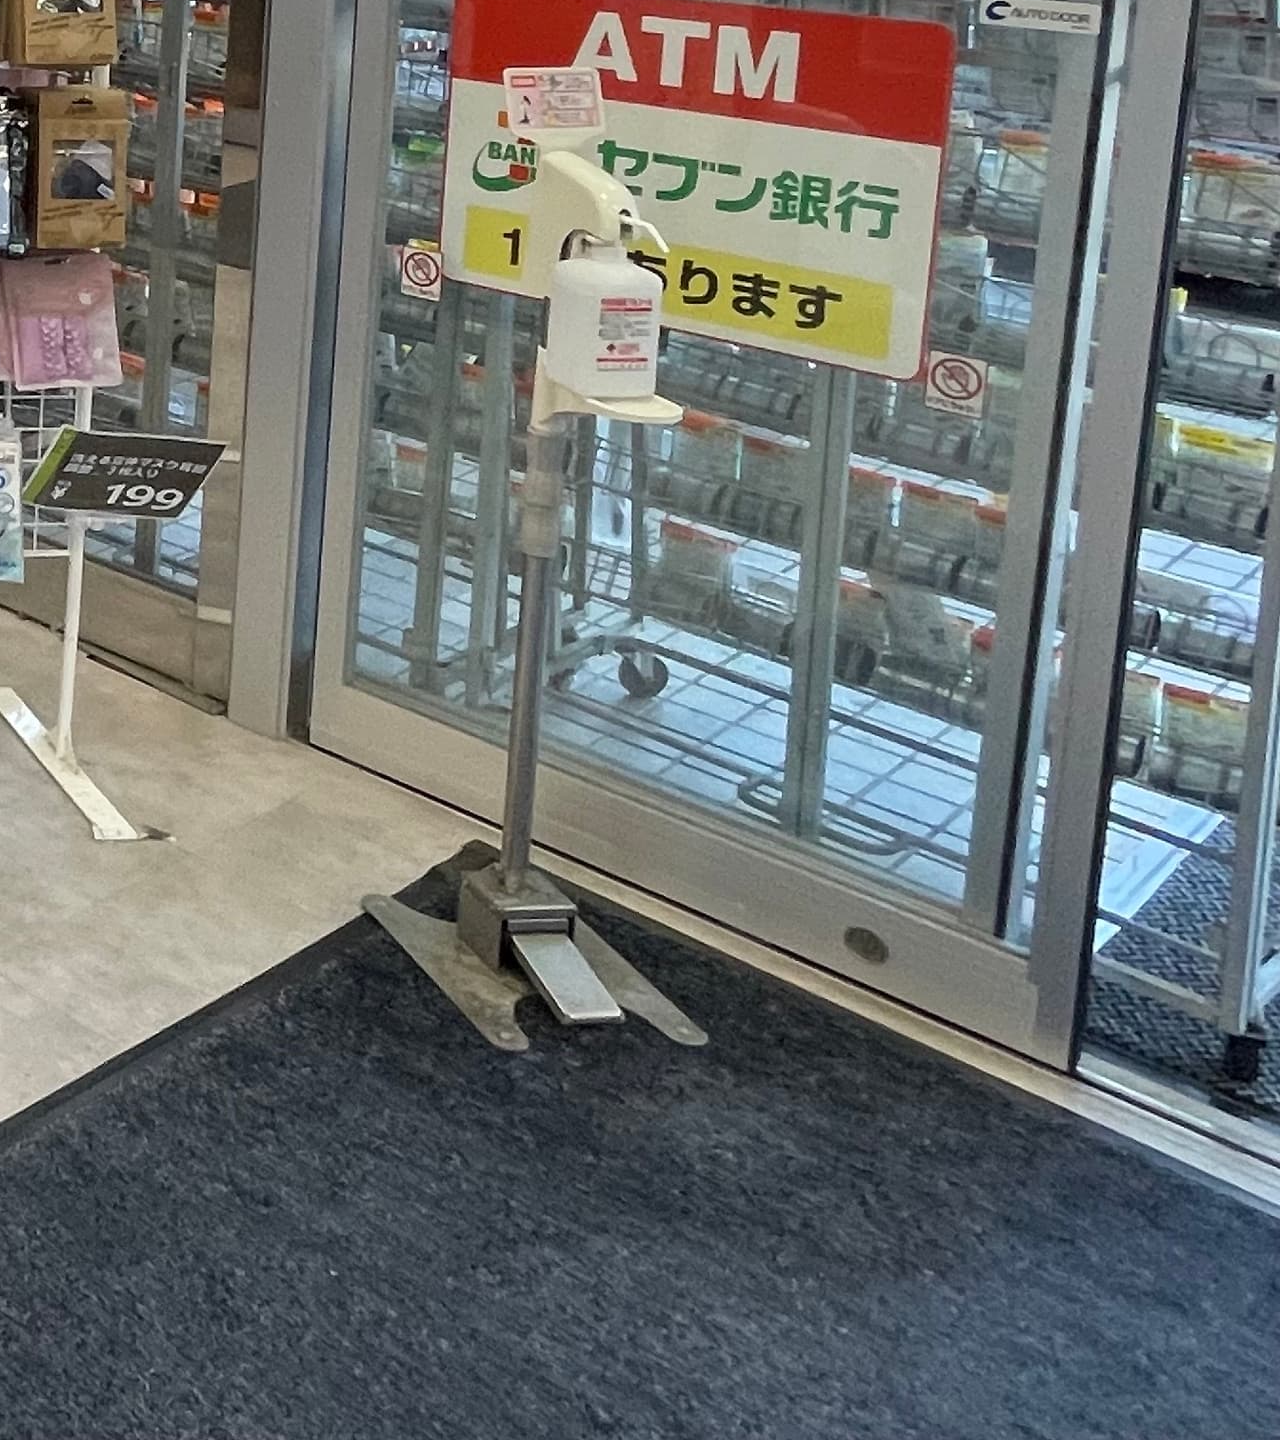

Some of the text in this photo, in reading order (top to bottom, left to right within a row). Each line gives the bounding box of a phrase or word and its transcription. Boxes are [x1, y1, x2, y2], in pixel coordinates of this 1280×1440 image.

[571, 11, 802, 103] ATM
[487, 140, 536, 165] BAN
[597, 139, 900, 239] セブン銀行
[105, 483, 185, 511] 199
